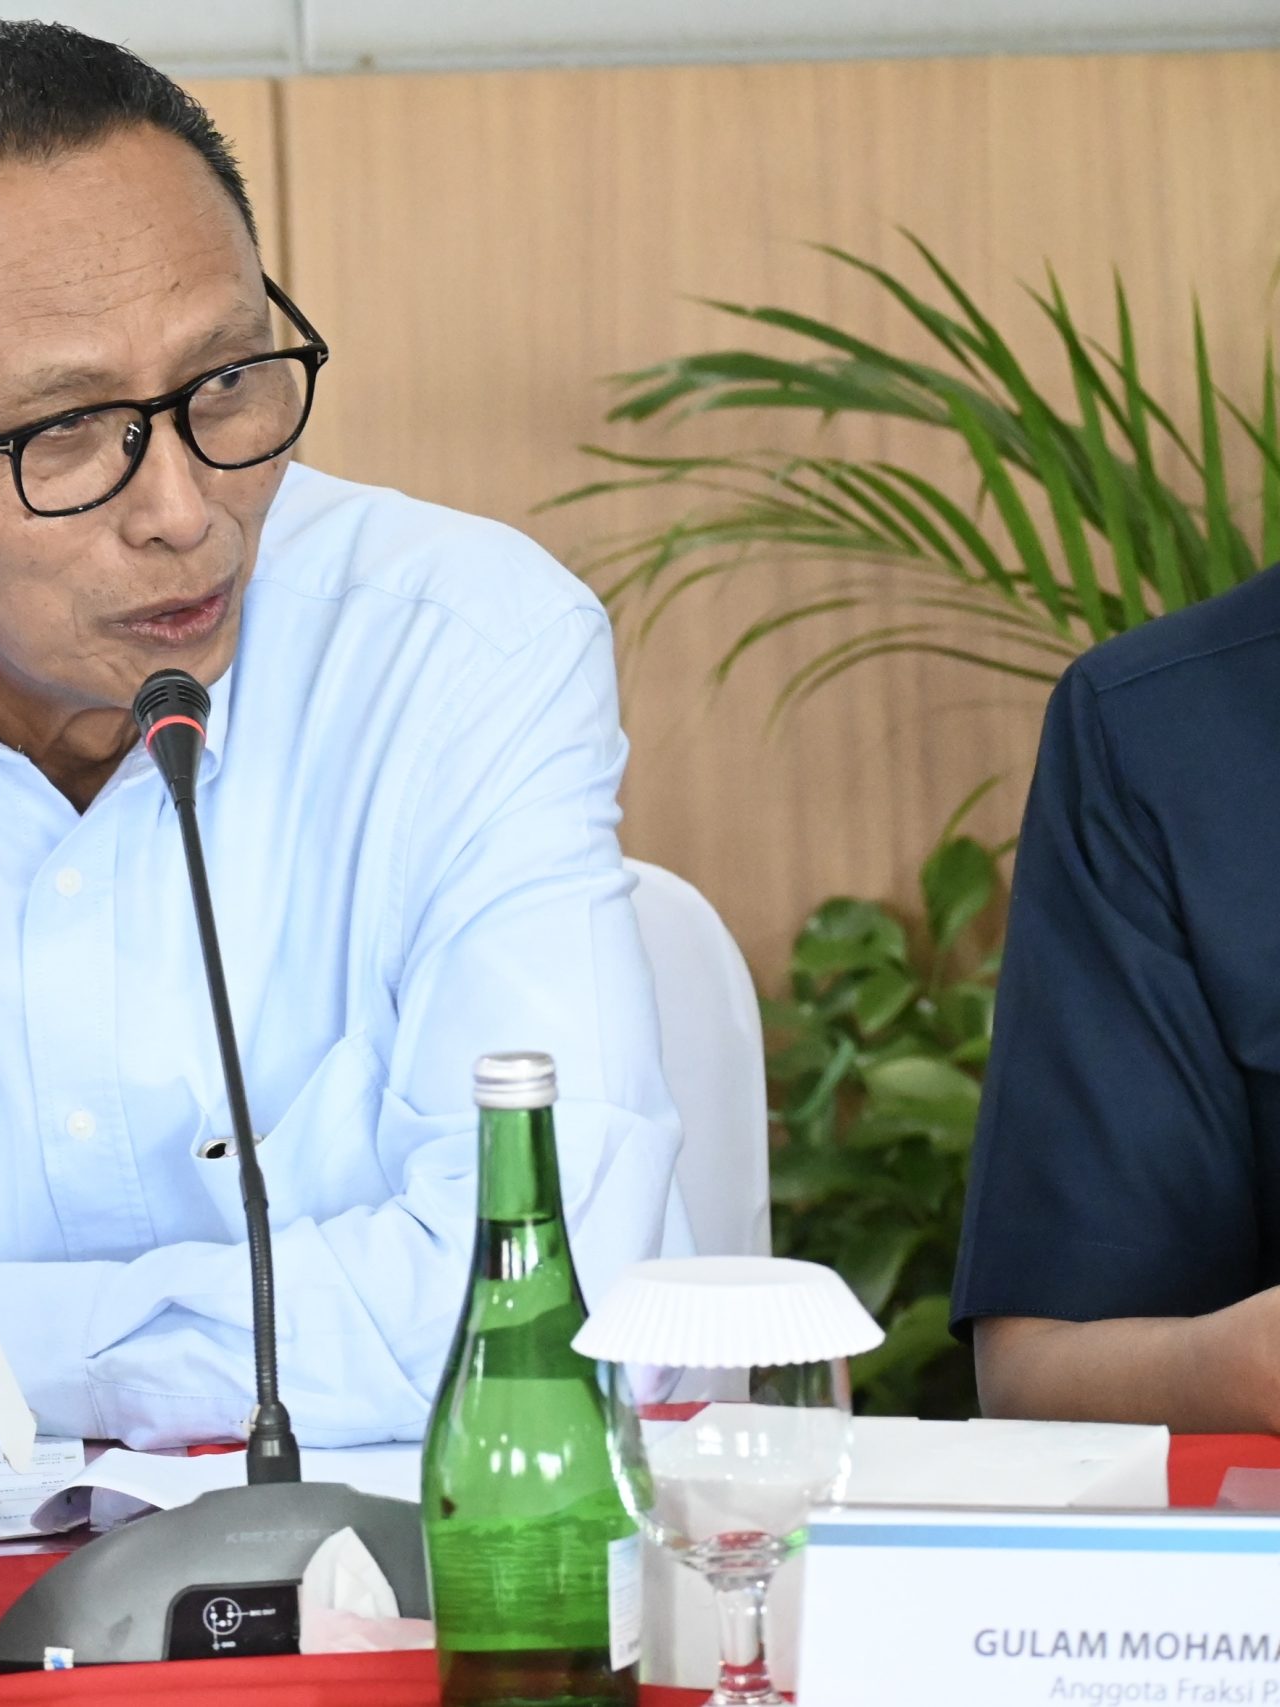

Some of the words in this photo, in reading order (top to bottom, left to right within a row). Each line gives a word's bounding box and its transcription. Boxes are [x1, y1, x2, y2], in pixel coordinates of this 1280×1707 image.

[974, 1628, 1108, 1659] GULAM
[1119, 1631, 1280, 1662] MOHAM
[1049, 1676, 1167, 1707] Anggota
[1177, 1677, 1254, 1704] Fraksi
[1262, 1679, 1280, 1704] P
